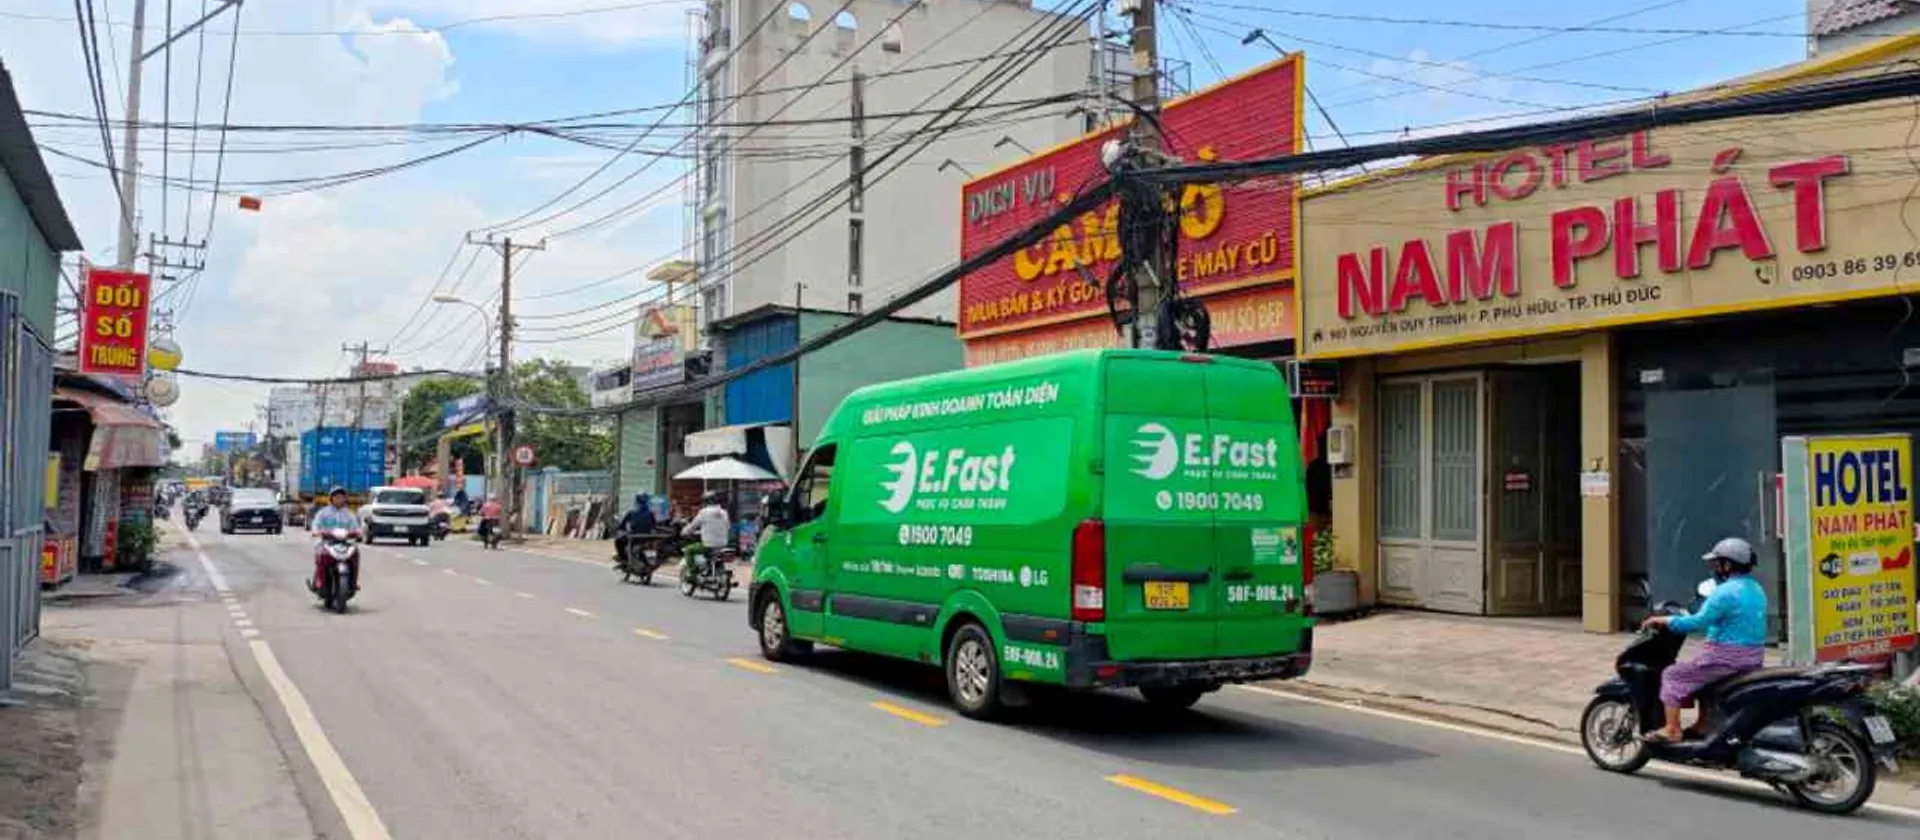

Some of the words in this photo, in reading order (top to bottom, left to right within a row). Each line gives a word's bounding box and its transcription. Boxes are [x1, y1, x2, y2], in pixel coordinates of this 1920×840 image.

[1023, 166, 1056, 207] VỤ
[1446, 130, 1671, 212] HOTEL
[1336, 221, 1521, 320] NAM
[1551, 147, 1851, 288] PHÁT
[1194, 241, 1240, 278] MÁY
[1245, 228, 1277, 266] CŨ
[1792, 262, 1837, 282] 0903
[1843, 258, 1867, 276] 86
[1872, 254, 1898, 271] 39
[96, 311, 133, 338] SỐ
[1184, 433, 1278, 468] E.Fast
[917, 444, 1016, 493] E.Fast
[1814, 449, 1907, 507] HOTEL
[1176, 491, 1218, 510] 1900
[1221, 491, 1263, 511] 7049
[910, 524, 938, 545] 1900
[939, 524, 973, 546] 7049
[1818, 514, 1857, 537] NAM
[1863, 504, 1907, 532] PHÁT
[1033, 569, 1049, 586] LG
